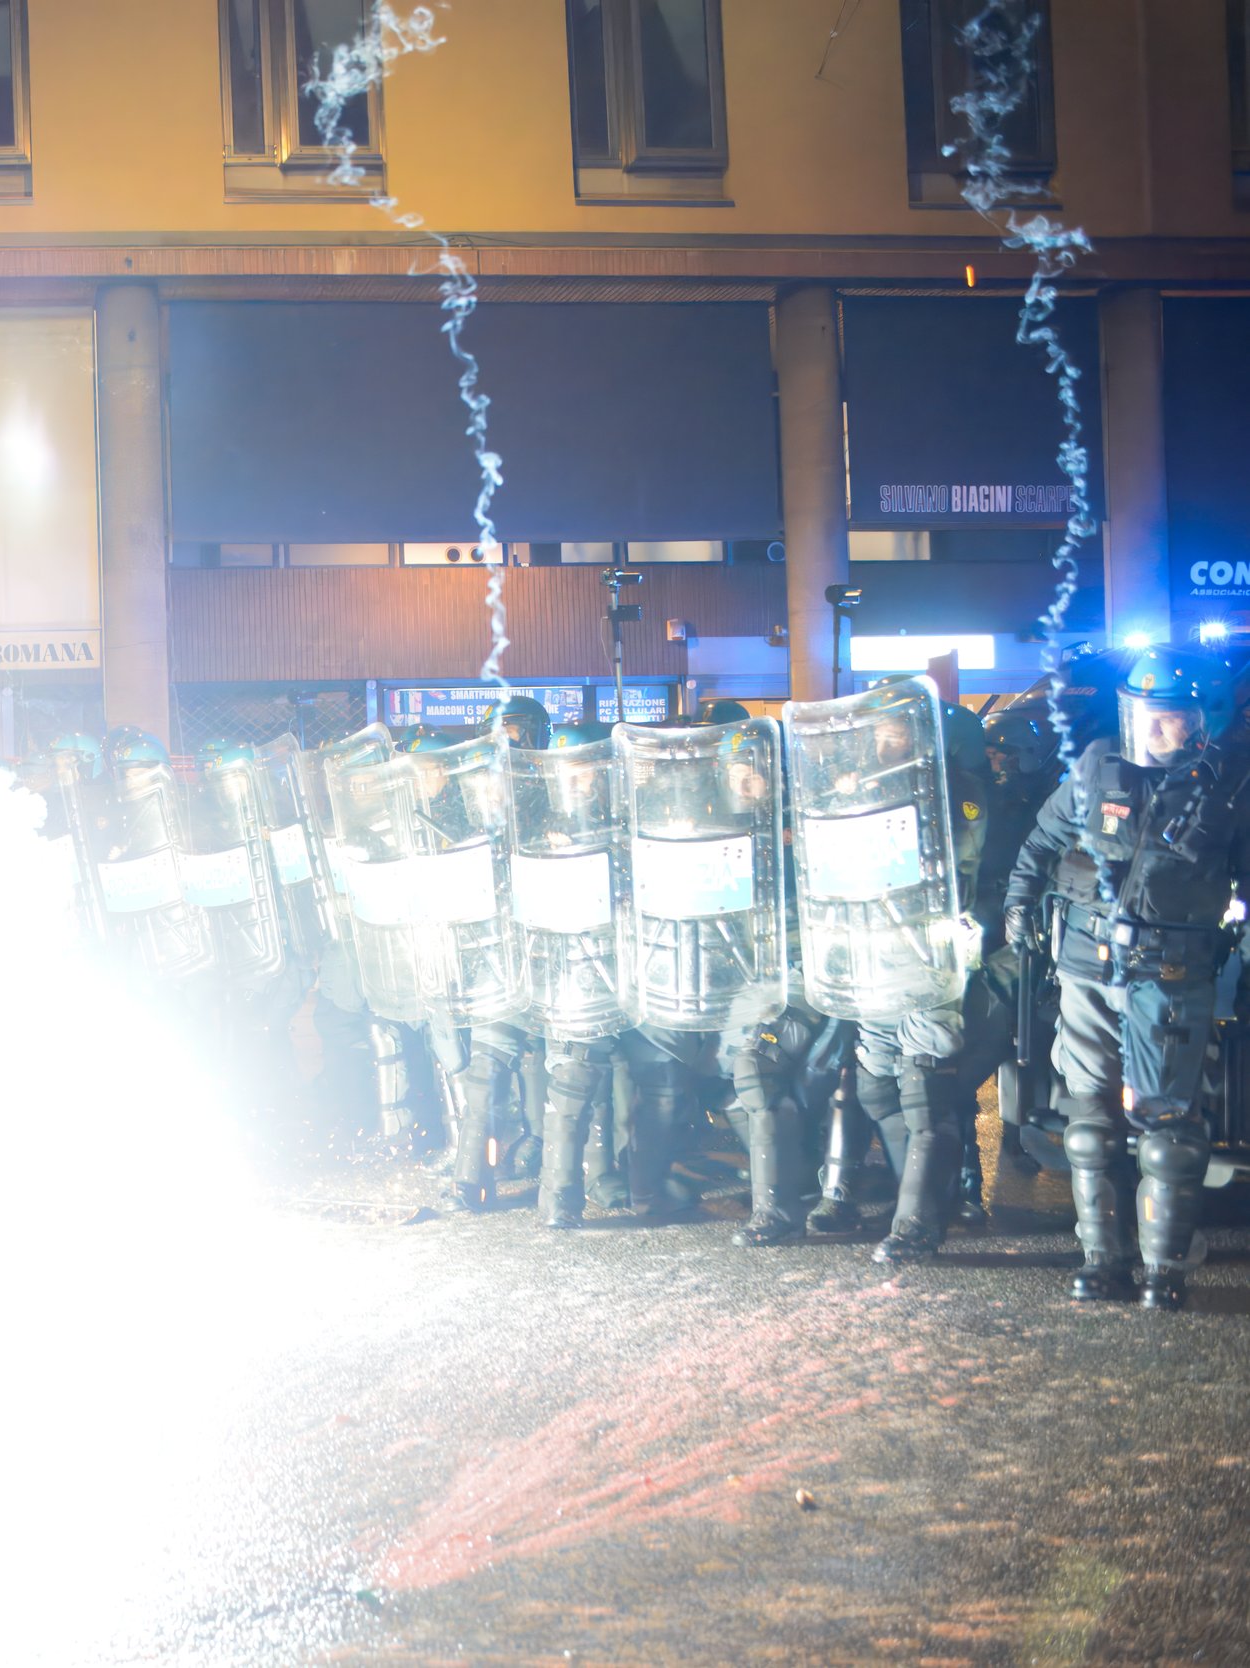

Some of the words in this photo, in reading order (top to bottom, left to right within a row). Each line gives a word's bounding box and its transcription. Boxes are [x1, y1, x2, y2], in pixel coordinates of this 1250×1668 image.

[879, 484, 949, 513] SILVANO
[951, 484, 1013, 513] BIAGINI
[1190, 560, 1250, 586] CON
[426, 705, 465, 716] MARCONI
